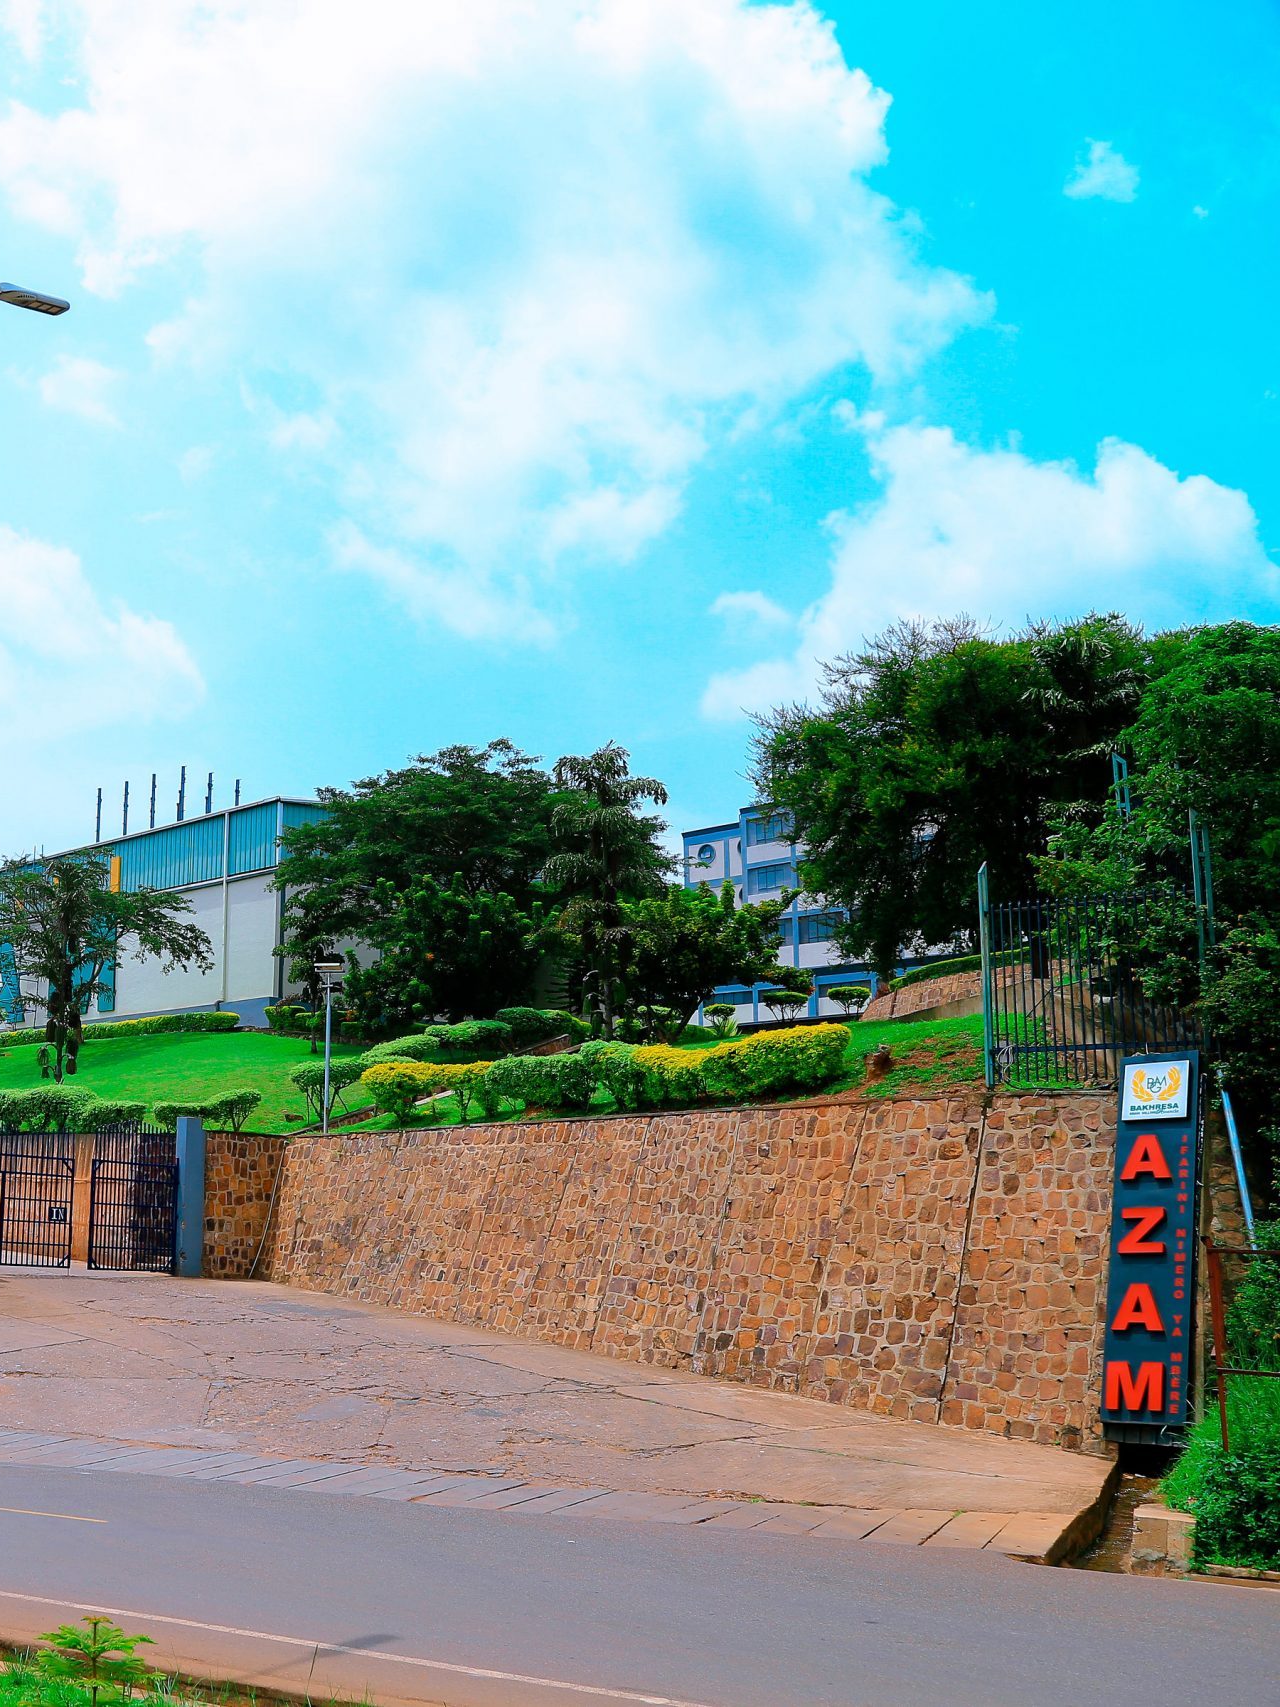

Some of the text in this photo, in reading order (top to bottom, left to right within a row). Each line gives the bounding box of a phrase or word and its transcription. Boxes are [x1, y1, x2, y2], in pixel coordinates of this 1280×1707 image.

[1130, 1103, 1179, 1111] BAKHRESA
[51, 1208, 64, 1220] IN
[1104, 1134, 1173, 1411] AZAM
[1169, 1135, 1189, 1414] IFARINI NIMERO YA MBERE
